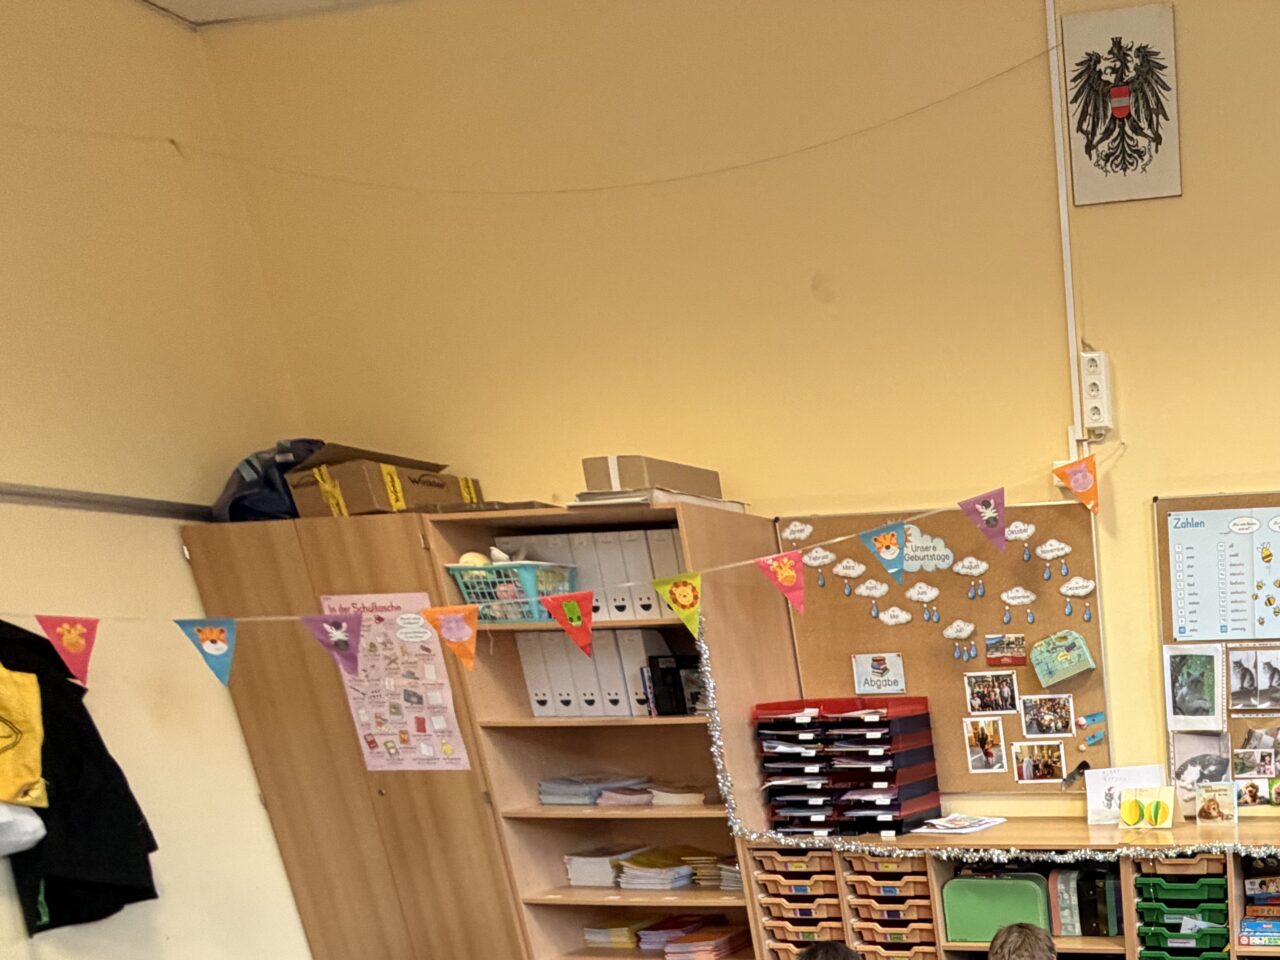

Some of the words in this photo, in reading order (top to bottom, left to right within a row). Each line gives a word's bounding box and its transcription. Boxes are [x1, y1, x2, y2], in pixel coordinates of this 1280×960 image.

[1173, 518, 1205, 530] Zahlen
[911, 545, 937, 553] Unsere
[904, 553, 950, 562] Geburtstage
[863, 677, 899, 689] Abgabe
